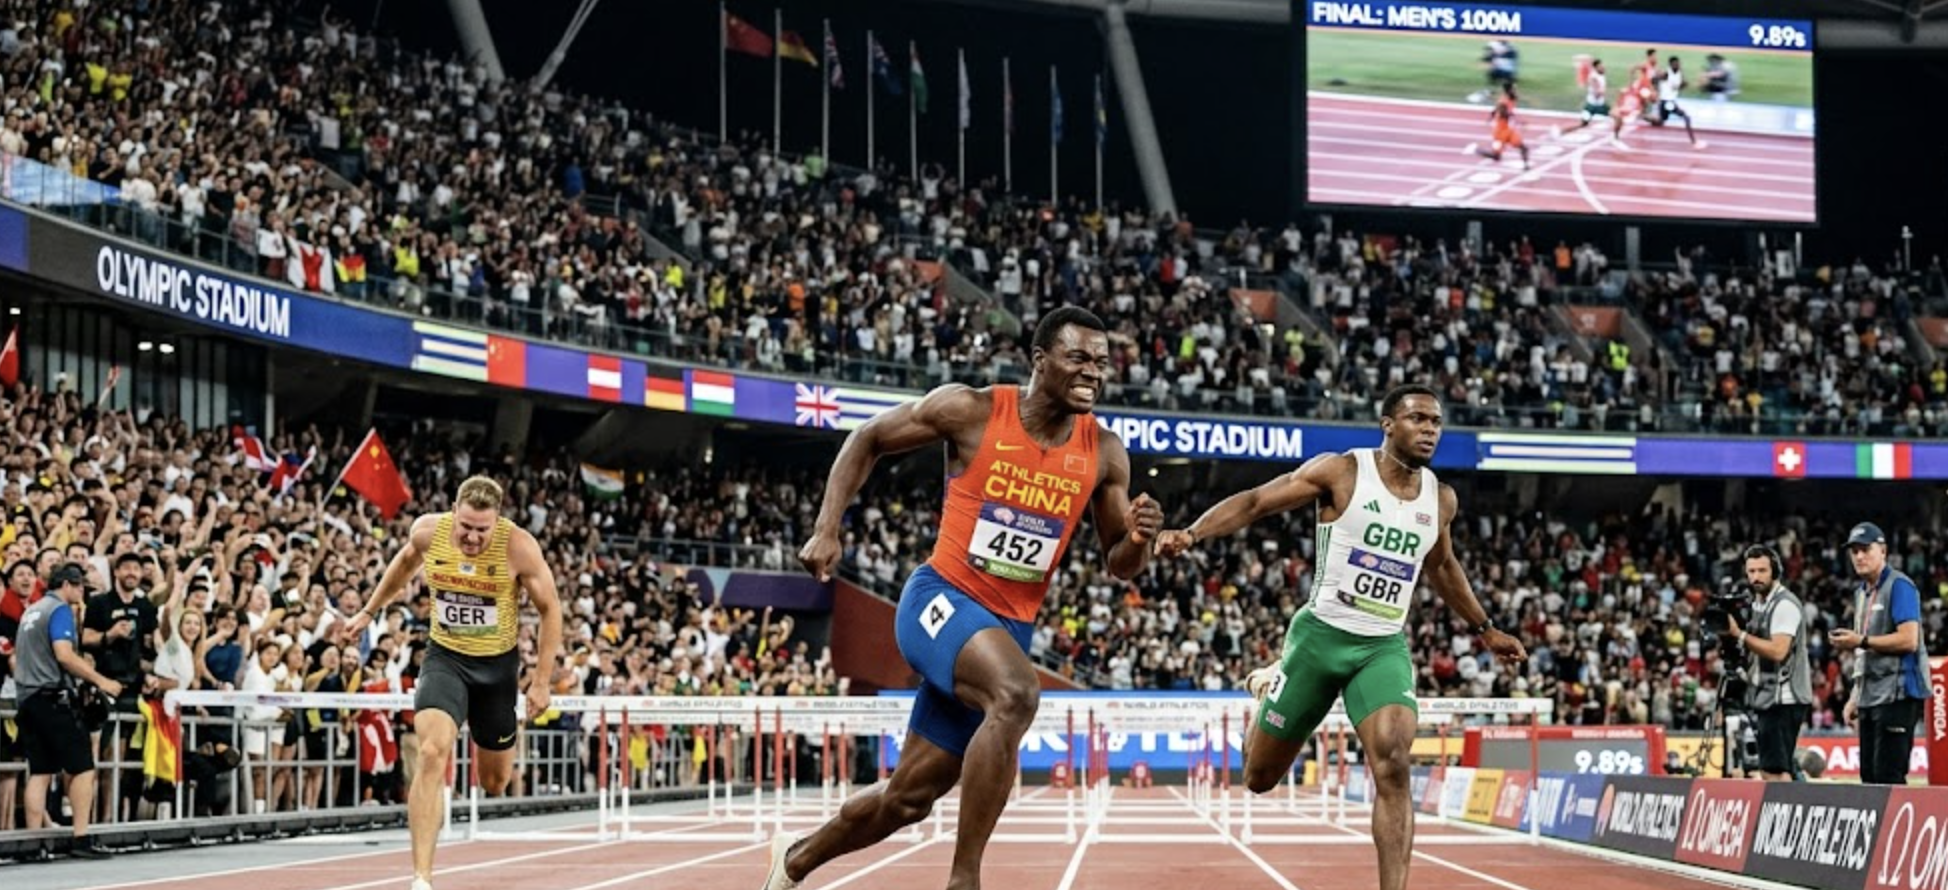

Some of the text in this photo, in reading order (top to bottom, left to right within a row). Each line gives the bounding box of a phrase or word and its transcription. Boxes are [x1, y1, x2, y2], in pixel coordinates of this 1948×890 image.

[1312, 1, 1521, 33] FINAL: MEN'S 100M
[1748, 23, 1806, 47] 9.89s
[97, 245, 291, 338] OLYMPIC STADIUM
[1174, 420, 1303, 458] STADIUM
[984, 474, 1072, 517] CHINA
[987, 530, 1043, 567] 452
[1363, 521, 1421, 557] GBR
[1353, 572, 1402, 605] GBR
[445, 605, 486, 626] GER
[930, 603, 945, 627] 4
[1574, 749, 1644, 775] 9.89s
[1609, 791, 1641, 834] WORLD
[1636, 793, 1685, 843] ATHLETICS
[1697, 798, 1751, 859] OMEGA
[1753, 801, 1877, 871] WORLD ATHLETICS
